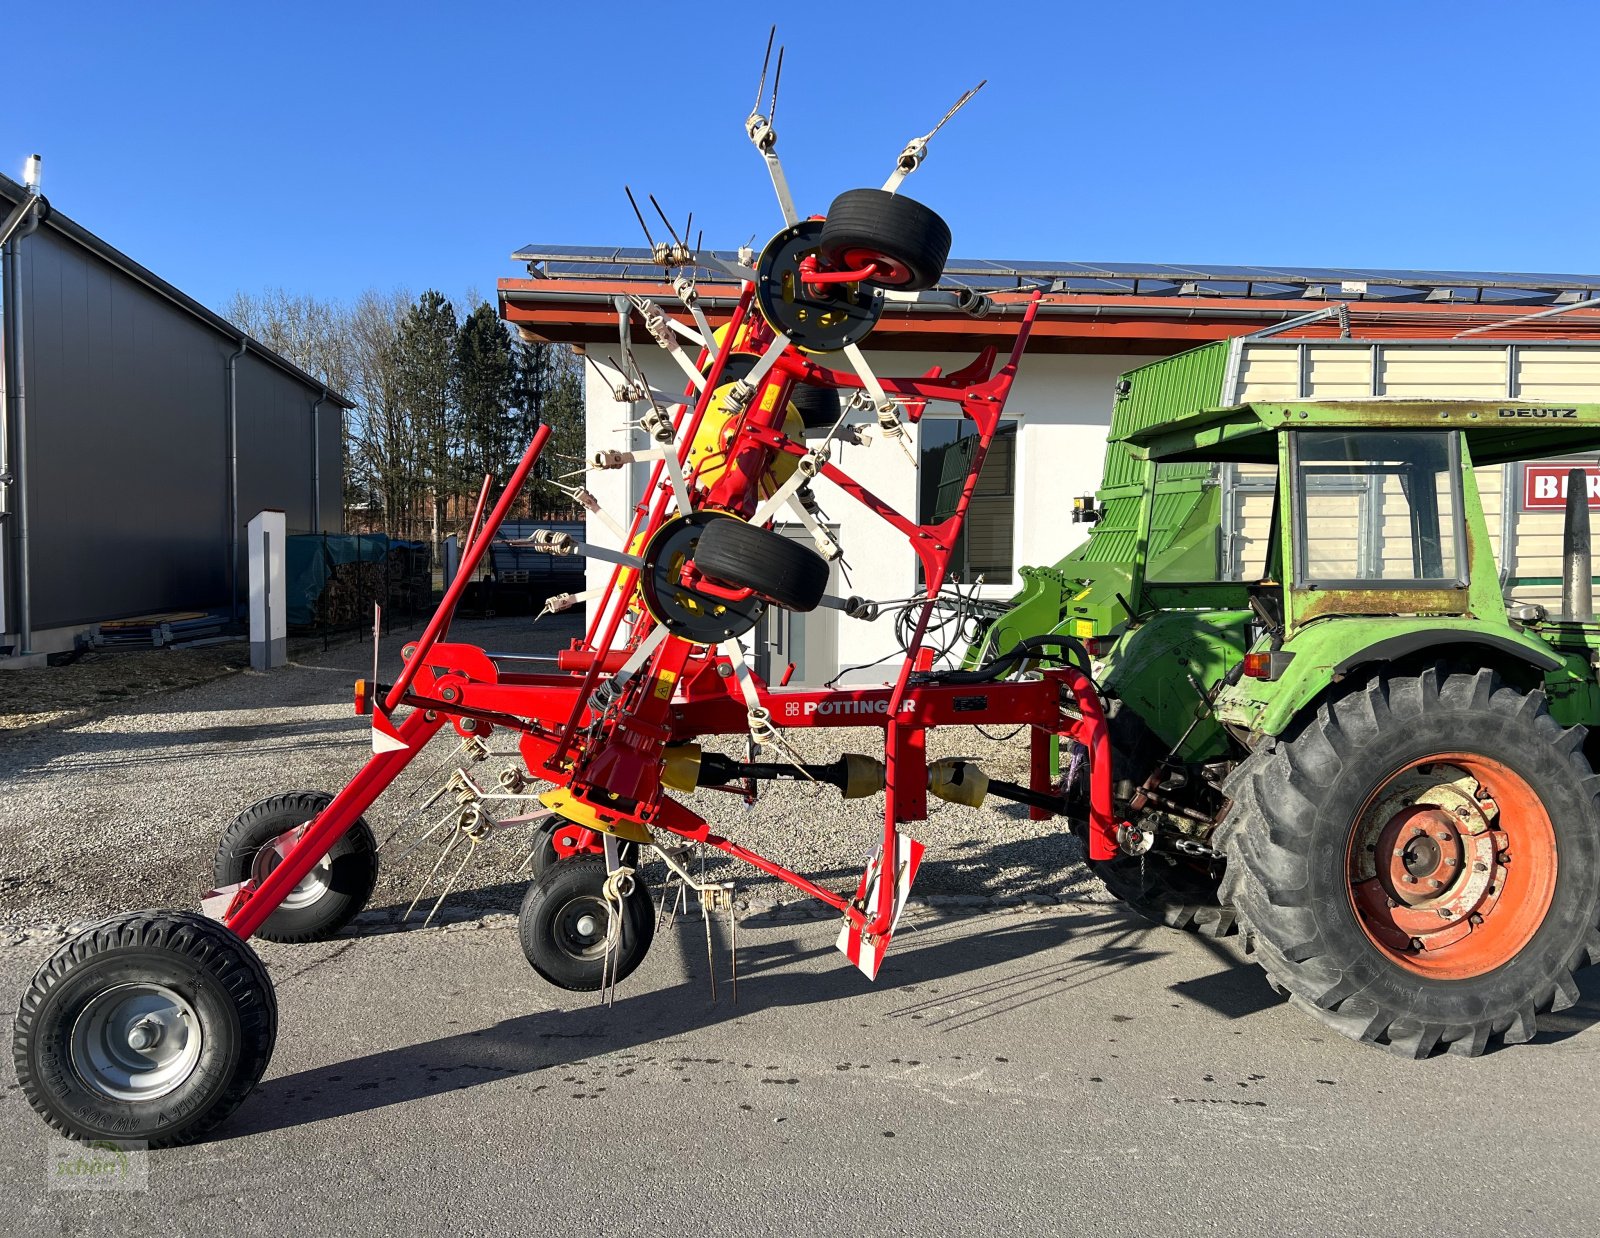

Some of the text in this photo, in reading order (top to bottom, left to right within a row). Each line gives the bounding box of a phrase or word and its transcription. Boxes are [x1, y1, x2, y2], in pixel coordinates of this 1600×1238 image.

[1498, 408, 1578, 418] DEUTZ
[803, 699, 916, 715] PÖTTINGR
[78, 1105, 112, 1128] 305
[111, 1117, 140, 1131] AW
